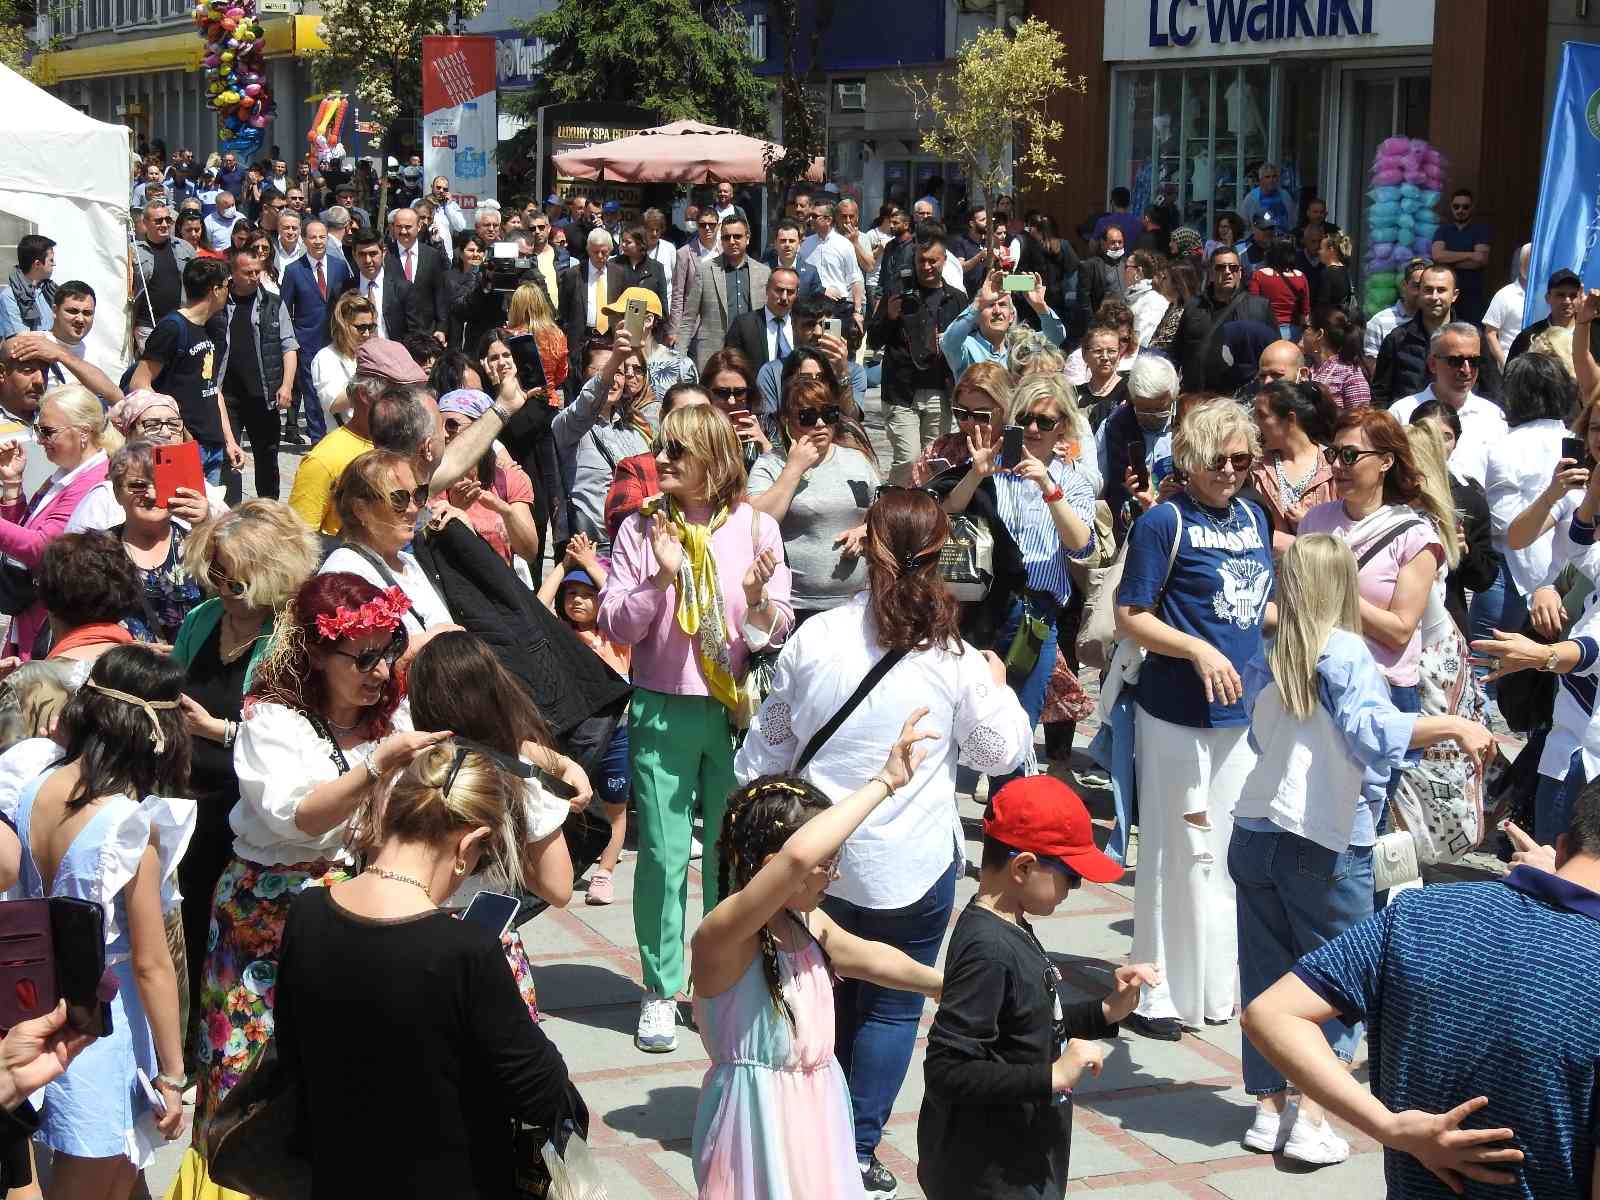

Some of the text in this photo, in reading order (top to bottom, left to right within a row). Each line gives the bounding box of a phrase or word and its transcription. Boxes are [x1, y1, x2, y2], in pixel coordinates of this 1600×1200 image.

[1149, 0, 1198, 47] LC
[557, 126, 591, 139] LUXURY
[593, 127, 610, 140] SPA
